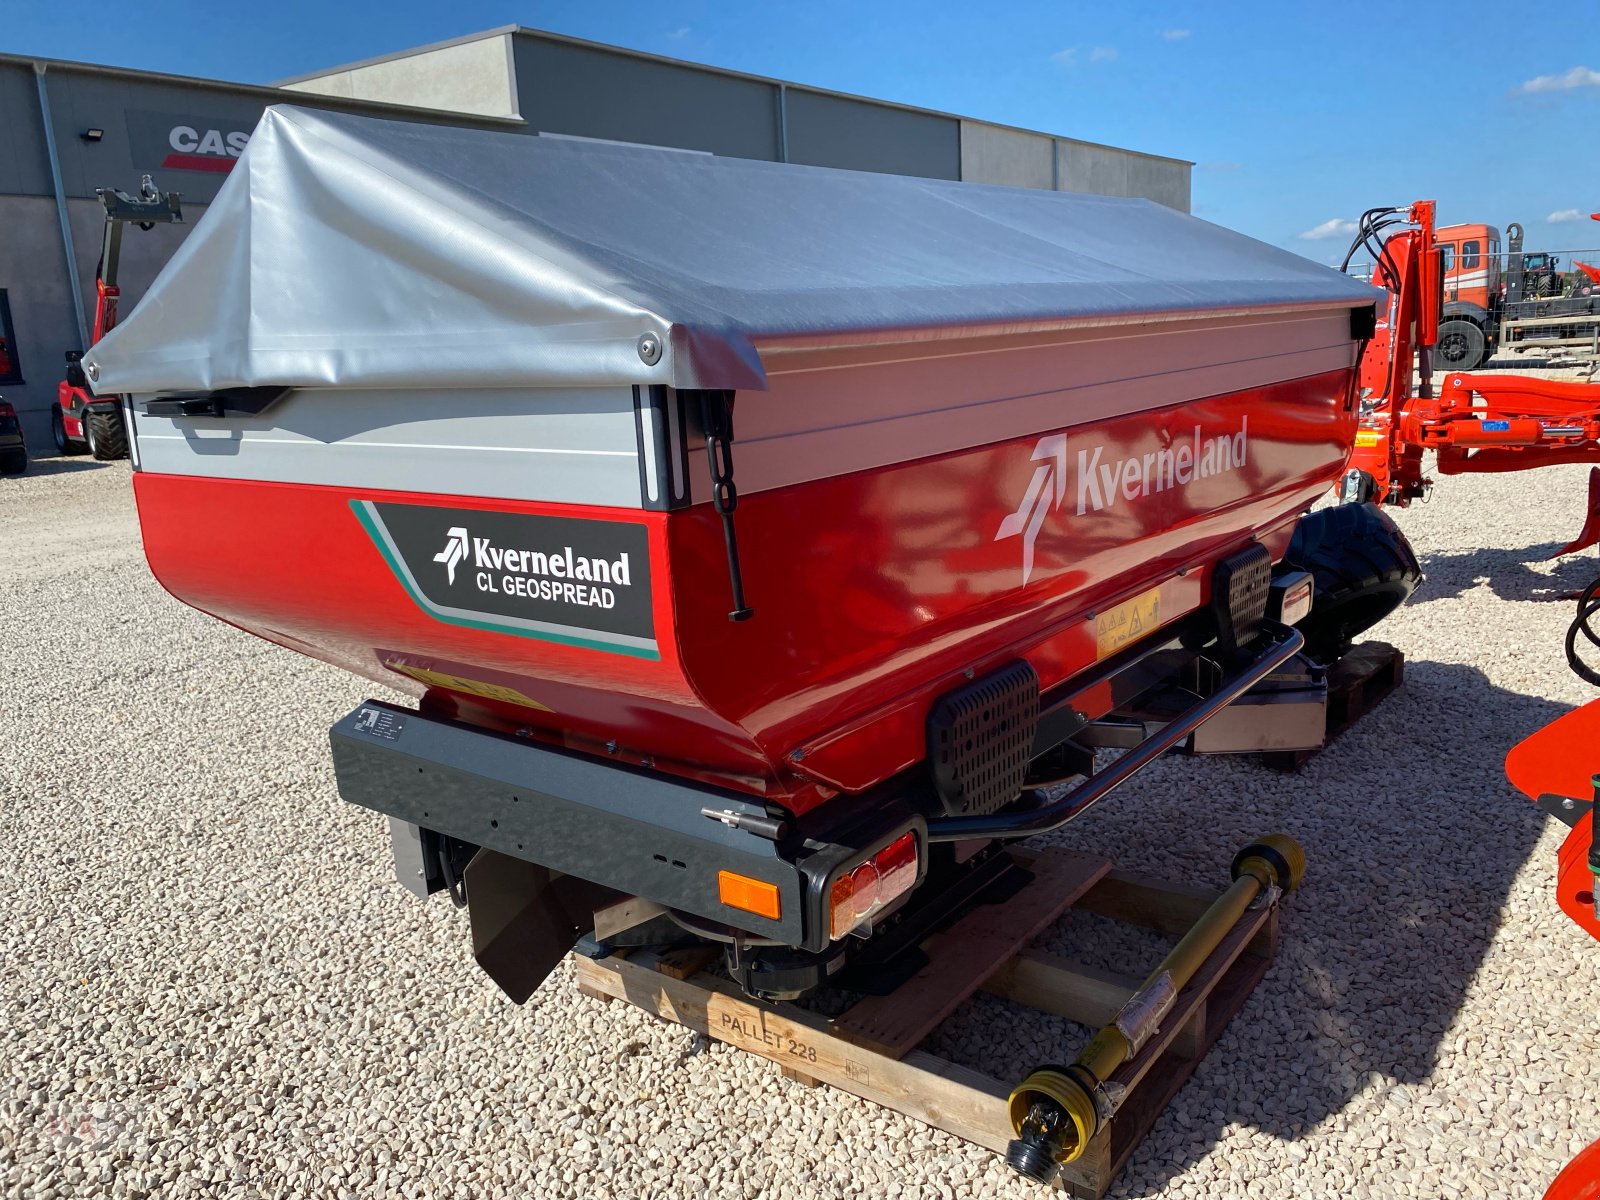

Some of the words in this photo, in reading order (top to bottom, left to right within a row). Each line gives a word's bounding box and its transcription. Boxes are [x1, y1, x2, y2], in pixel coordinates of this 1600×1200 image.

[1076, 414, 1248, 517] Kverneland
[472, 537, 632, 586] Kverneland
[476, 571, 499, 593] CL
[502, 574, 616, 609] GEOSPREAD
[721, 1011, 783, 1049] PALLET
[788, 1038, 818, 1063] 228
